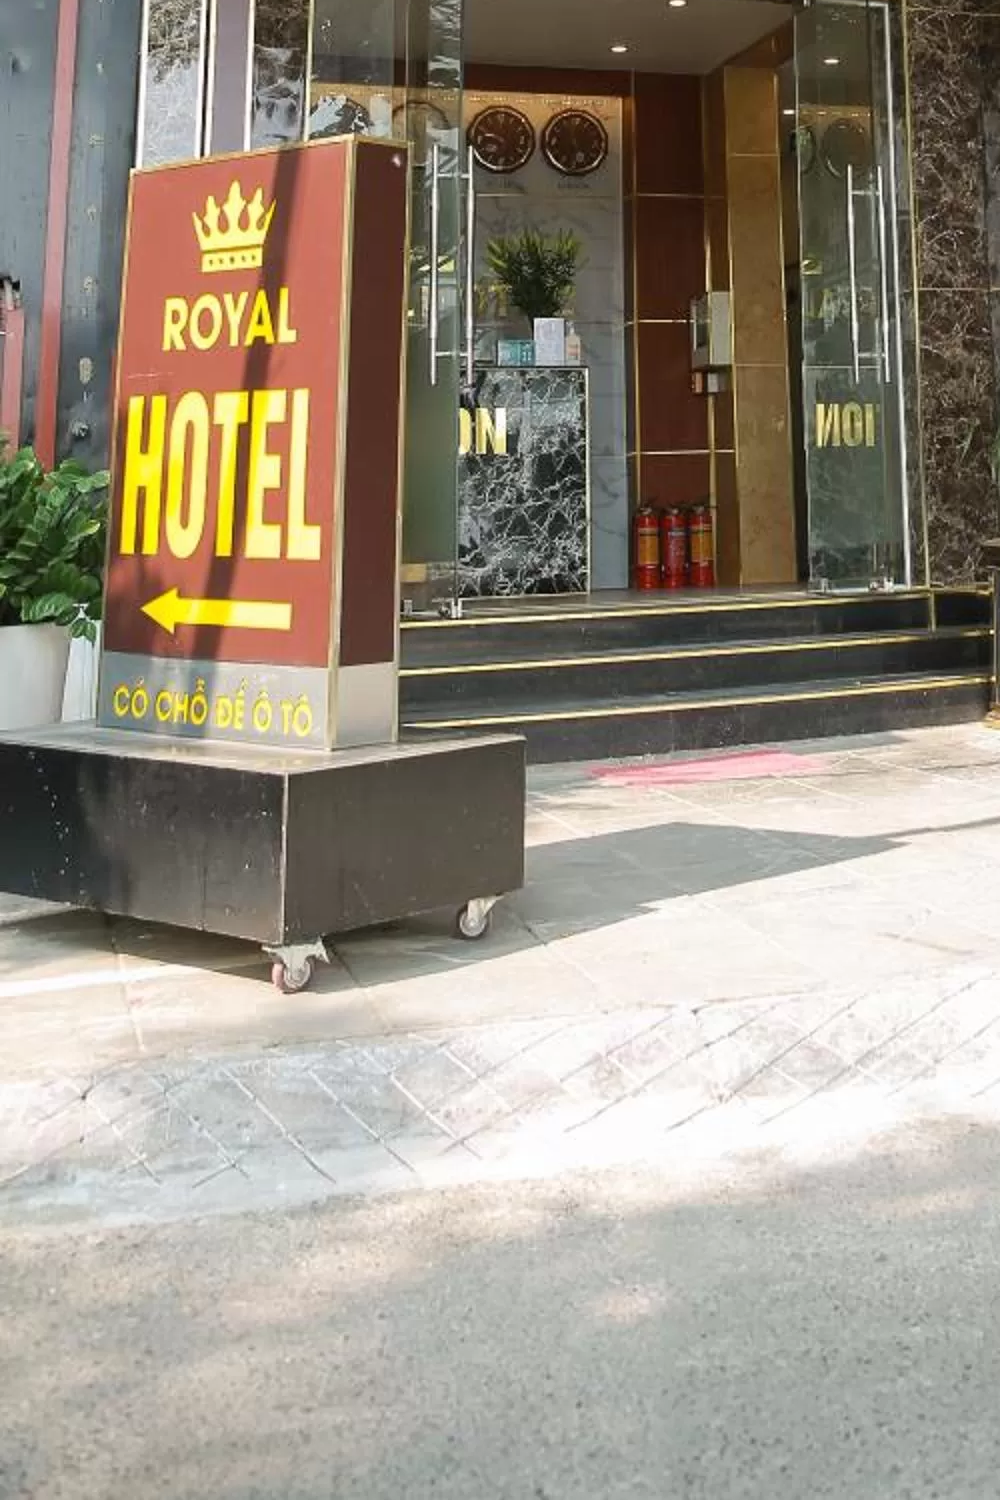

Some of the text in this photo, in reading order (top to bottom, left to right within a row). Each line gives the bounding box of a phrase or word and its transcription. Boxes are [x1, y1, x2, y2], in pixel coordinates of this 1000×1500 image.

[162, 287, 297, 352] ROYAL
[119, 388, 321, 560] HOTEL
[113, 676, 148, 718] CÓ
[253, 686, 272, 733] Ô
[280, 692, 313, 738] TÔ
